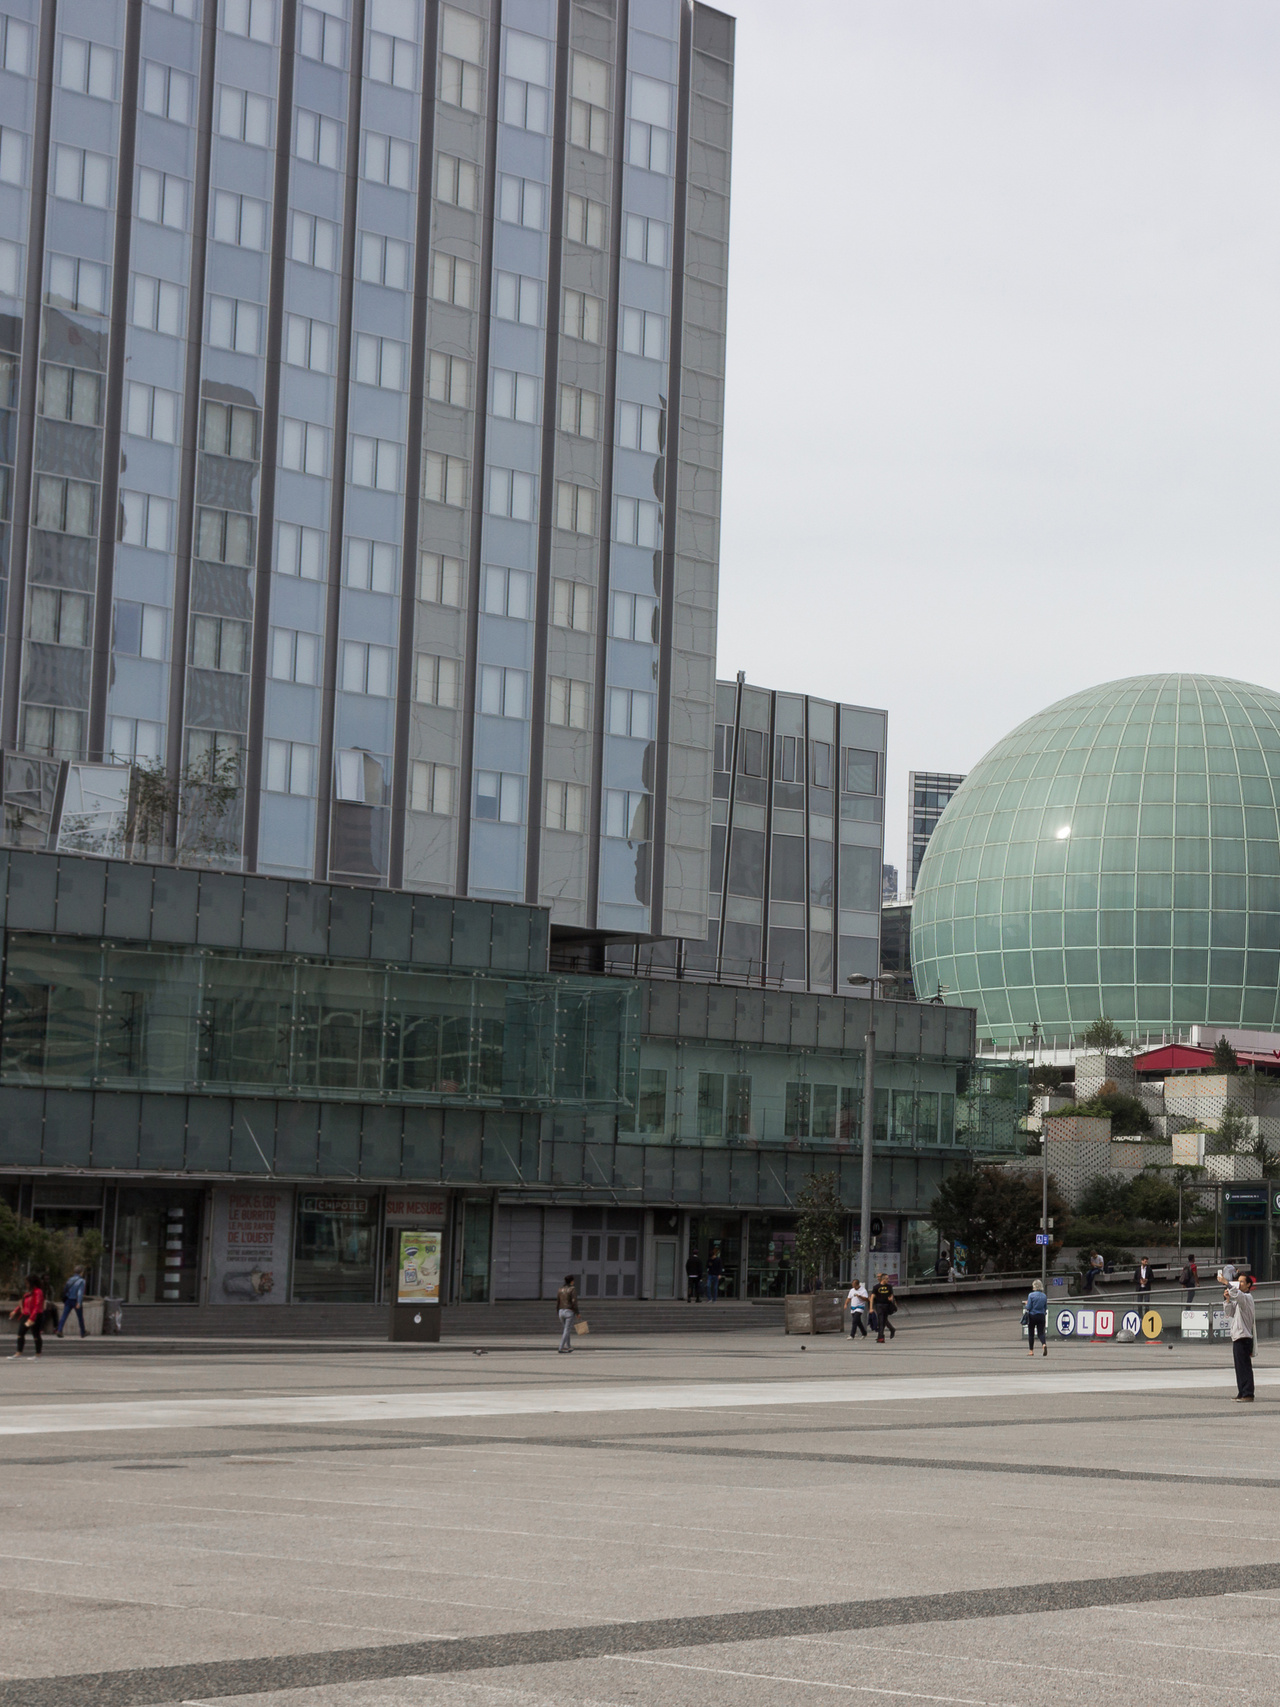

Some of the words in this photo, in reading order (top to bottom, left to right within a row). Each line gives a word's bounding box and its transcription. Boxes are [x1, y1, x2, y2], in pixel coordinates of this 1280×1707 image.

[229, 1194, 252, 1208] PICK
[318, 1199, 365, 1211] CHIPOTLE
[386, 1201, 403, 1214] SUR
[406, 1201, 445, 1215] MESURE
[228, 1209, 239, 1220] LE
[241, 1209, 276, 1222] BURRITO
[227, 1232, 239, 1243] DE
[241, 1232, 275, 1244] L'OUEST
[1100, 1316, 1109, 1330] U
[1126, 1316, 1137, 1331] M
